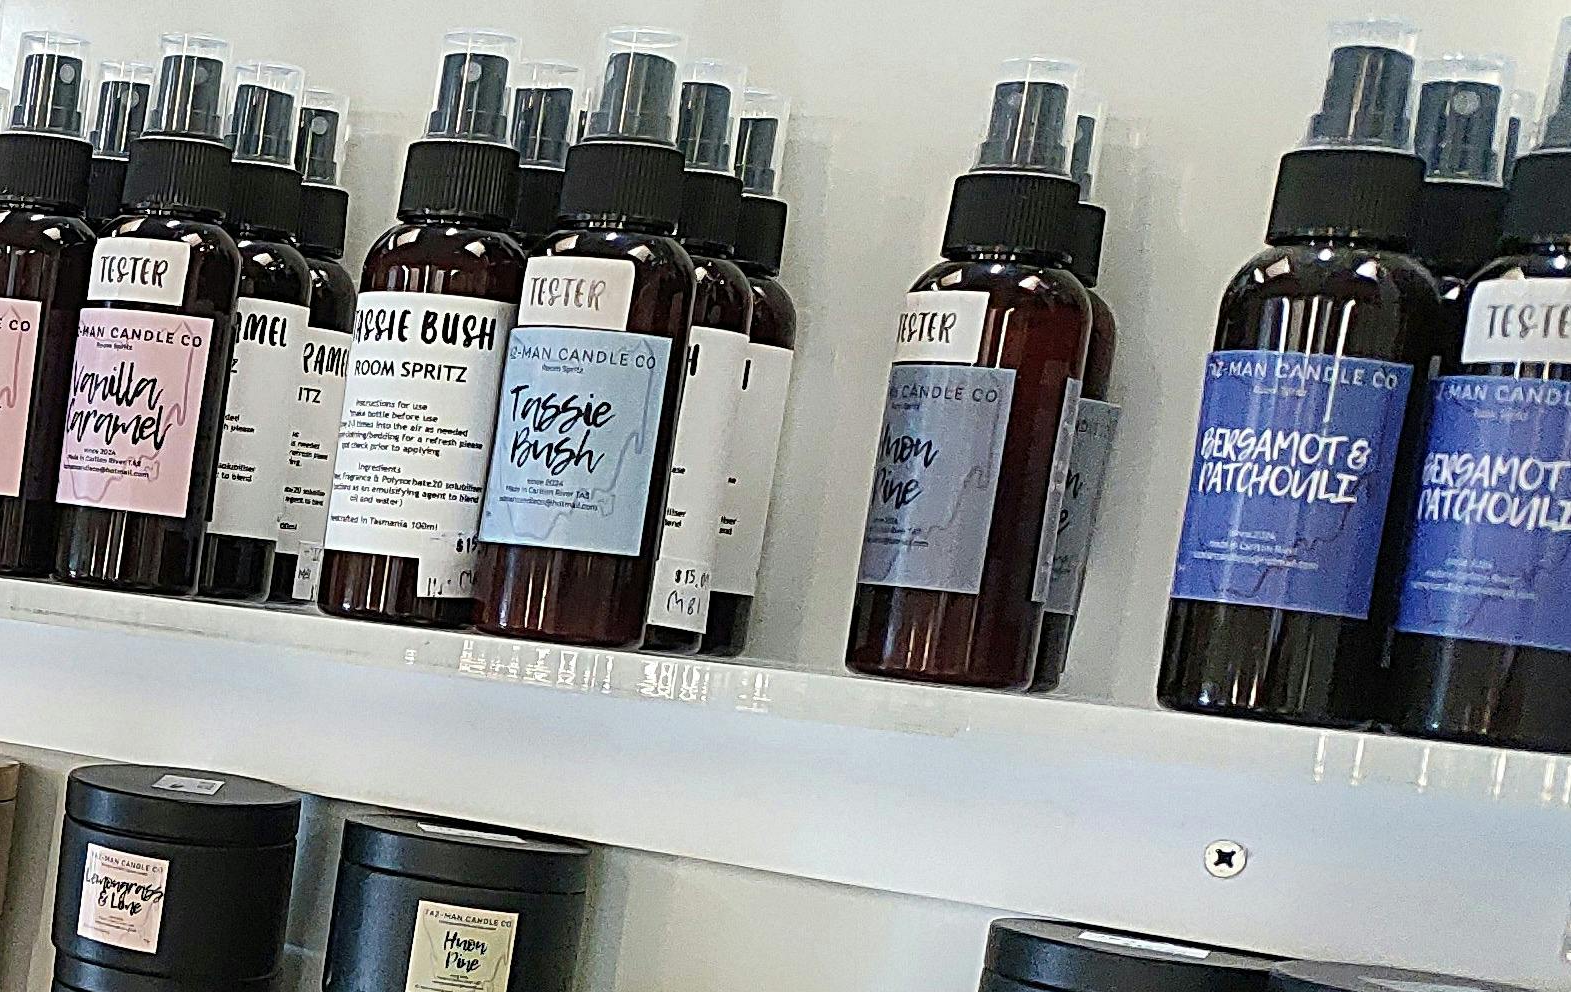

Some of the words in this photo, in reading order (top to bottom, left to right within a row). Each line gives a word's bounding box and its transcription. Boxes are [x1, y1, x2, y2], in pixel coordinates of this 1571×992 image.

[100, 255, 168, 288] TESTER
[530, 276, 607, 310] TESTER
[9, 319, 31, 332] CO
[110, 326, 174, 345] CANDLE
[181, 334, 202, 348] CO
[420, 311, 497, 350] BUSH
[558, 347, 629, 367] CANDLE
[635, 353, 656, 369] CO
[354, 359, 395, 377] ROOM
[400, 361, 468, 383] SPRITZ
[1277, 361, 1366, 389] CANDLE
[1373, 371, 1398, 391] CO
[74, 360, 165, 411] Vanilla
[901, 384, 964, 400] CANDLE
[972, 388, 998, 402] CO
[391, 412, 421, 422] before
[397, 401, 409, 410] for
[510, 384, 615, 434] Tassie
[436, 425, 469, 437] needed
[510, 429, 606, 477] Bush
[1200, 426, 1347, 464] BERGAMOT
[1348, 438, 1371, 470] &
[1198, 458, 1359, 505] PATCHOULI
[465, 915, 499, 928] CANDLE
[500, 920, 513, 928] CO
[443, 930, 488, 955] Huon
[444, 951, 482, 972] Pine
